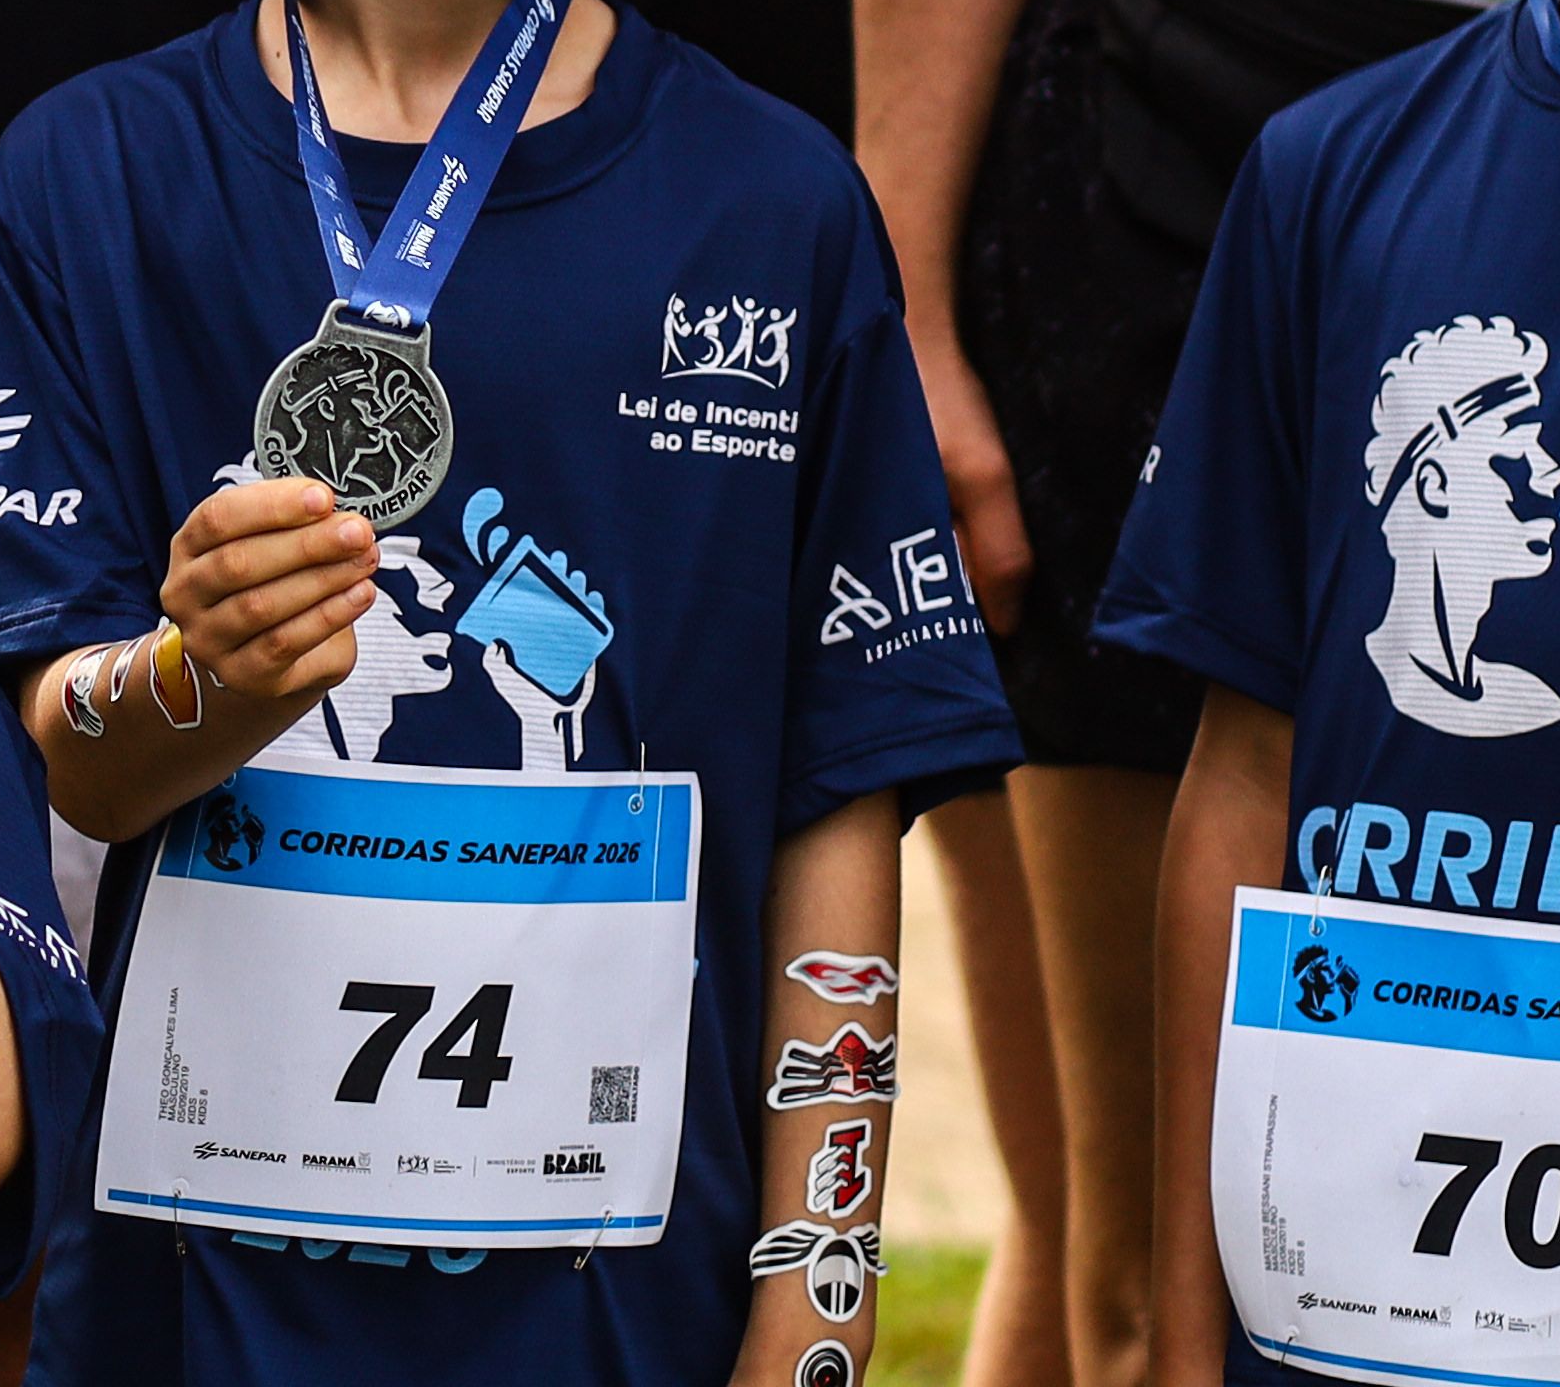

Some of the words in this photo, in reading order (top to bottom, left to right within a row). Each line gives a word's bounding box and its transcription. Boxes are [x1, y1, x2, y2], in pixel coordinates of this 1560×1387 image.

[505, 7, 540, 76] CORRIDAS
[476, 63, 514, 124] SANEPAR
[425, 174, 458, 220] SANEPAR
[618, 392, 658, 420] Lei
[665, 399, 698, 424] de
[650, 432, 682, 452] ao
[691, 429, 796, 462] Esporte
[279, 828, 448, 864] CORRIDAS
[457, 841, 588, 866] SANEPAR
[593, 841, 641, 865] 2026
[168, 987, 179, 1014] LIMA
[1372, 978, 1518, 1018] CORRIDAS
[162, 1016, 177, 1088] GONCALVES
[334, 981, 514, 1108] 74
[168, 1053, 182, 1122] MASCULINO
[177, 1066, 190, 1123] 05/09/2019
[159, 1089, 170, 1120] THEO
[188, 1097, 198, 1124] KIDS
[198, 1098, 208, 1125] KIDS
[1264, 1094, 1279, 1172] STRAPASSON
[220, 1148, 288, 1164] SANEPAR
[302, 1154, 356, 1167] PARANÁ
[543, 1152, 606, 1175] BRASIL
[1263, 1225, 1273, 1271] MATEUS
[1270, 1206, 1278, 1272] MASCULINO
[1288, 1248, 1296, 1275] KIDS
[1297, 1249, 1305, 1276] KIDS
[1320, 1298, 1377, 1315] SANEPAR
[1390, 1306, 1438, 1320] PARANÁ
